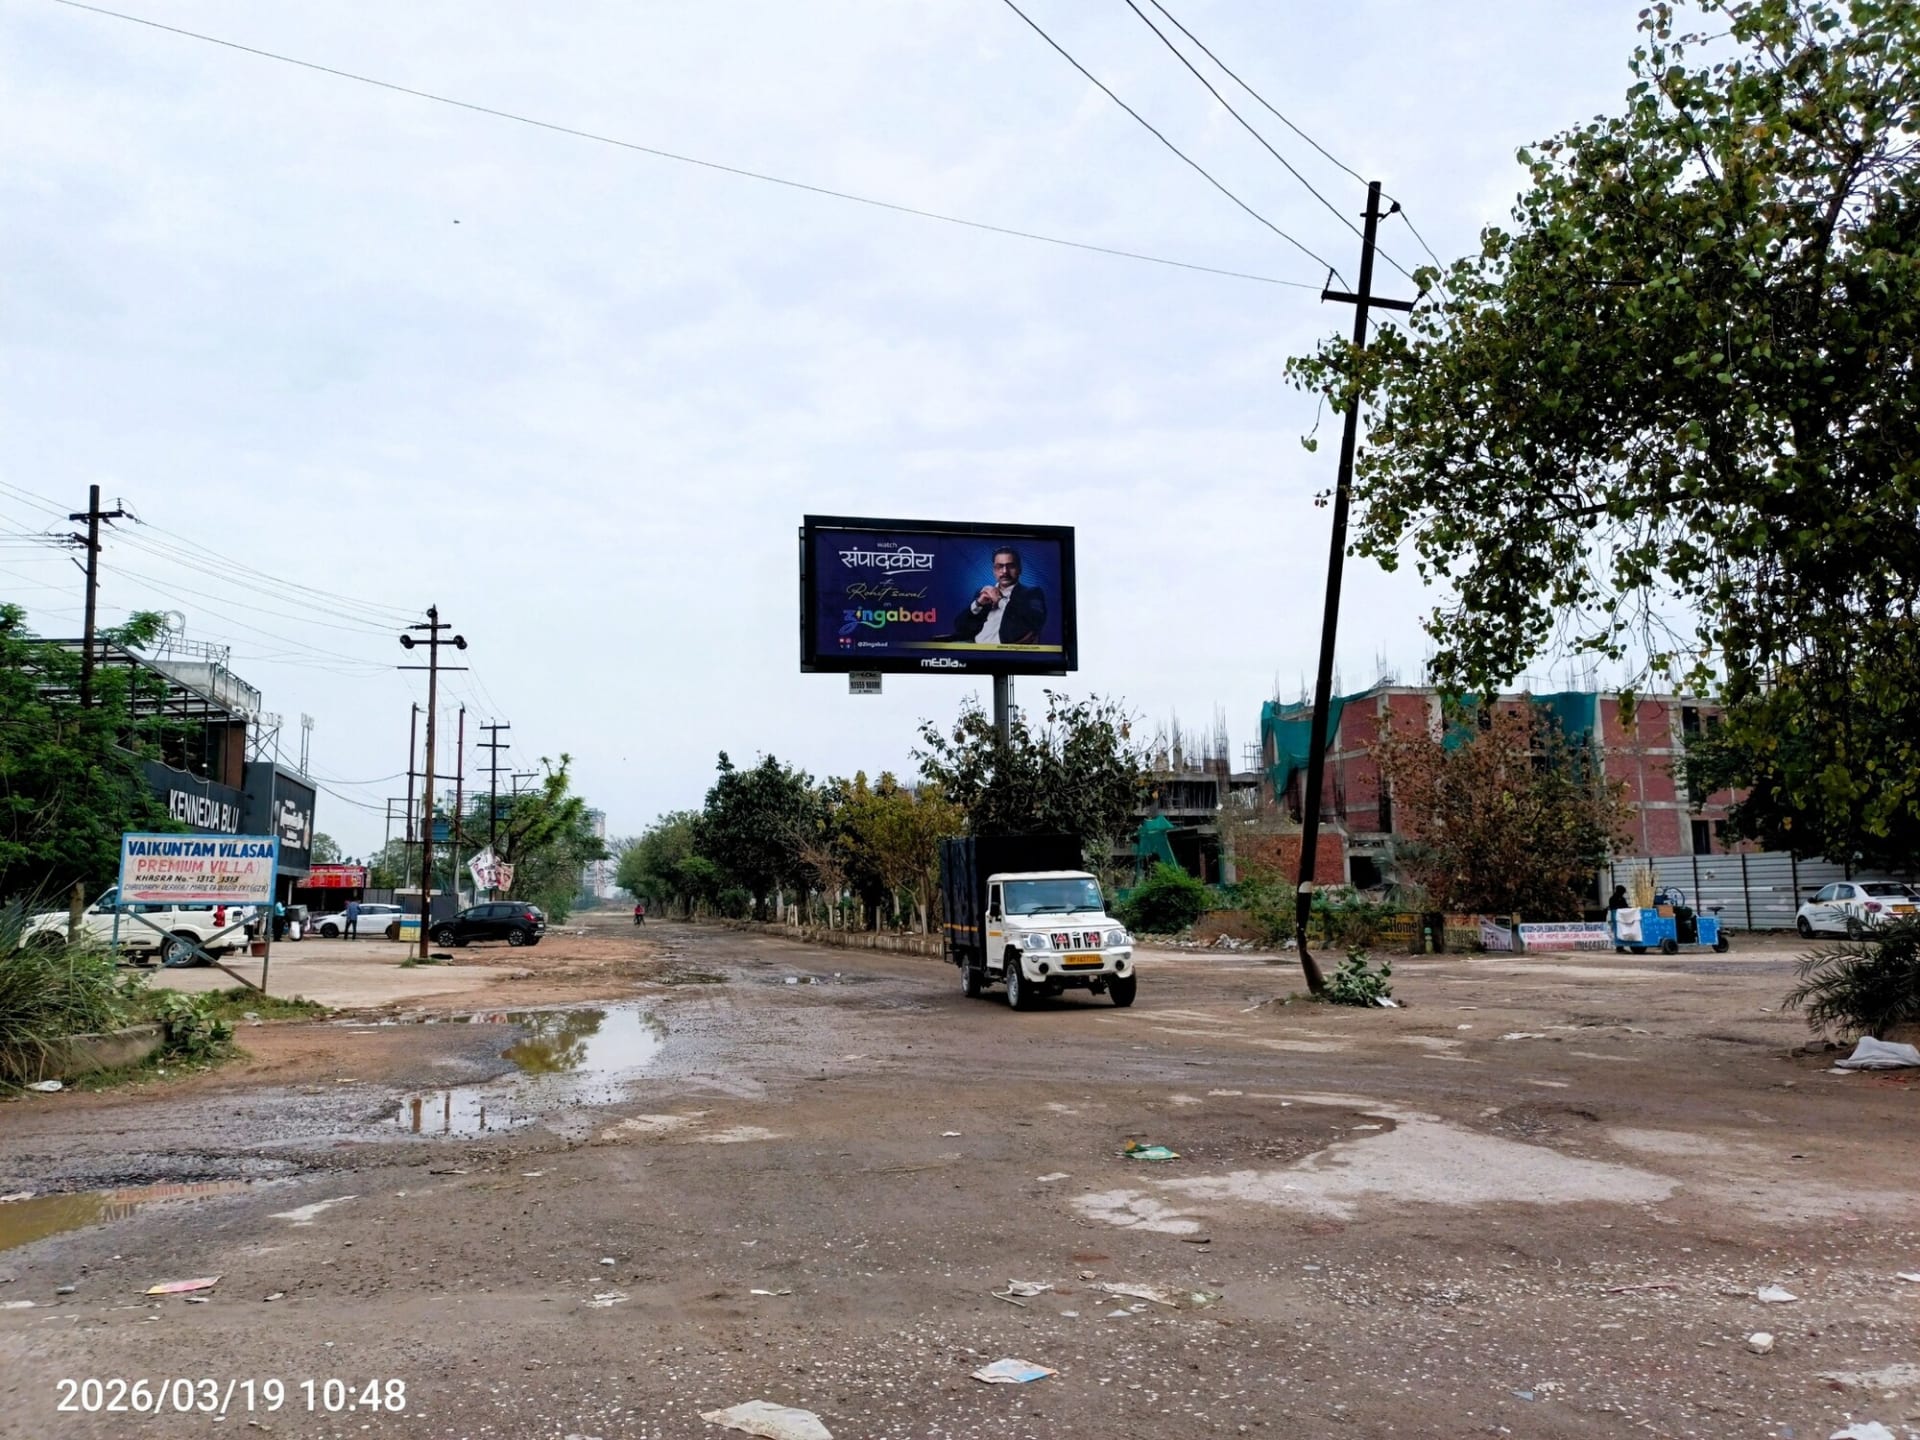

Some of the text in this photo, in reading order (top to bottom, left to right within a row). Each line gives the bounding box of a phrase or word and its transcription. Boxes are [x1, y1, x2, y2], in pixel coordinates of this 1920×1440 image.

[839, 546, 935, 570] संपादकीय
[839, 606, 937, 635] zingabad
[169, 788, 220, 831] KENNEDIA
[220, 803, 240, 835] BLU
[127, 840, 274, 859] VAIKUNTAM VILASAA
